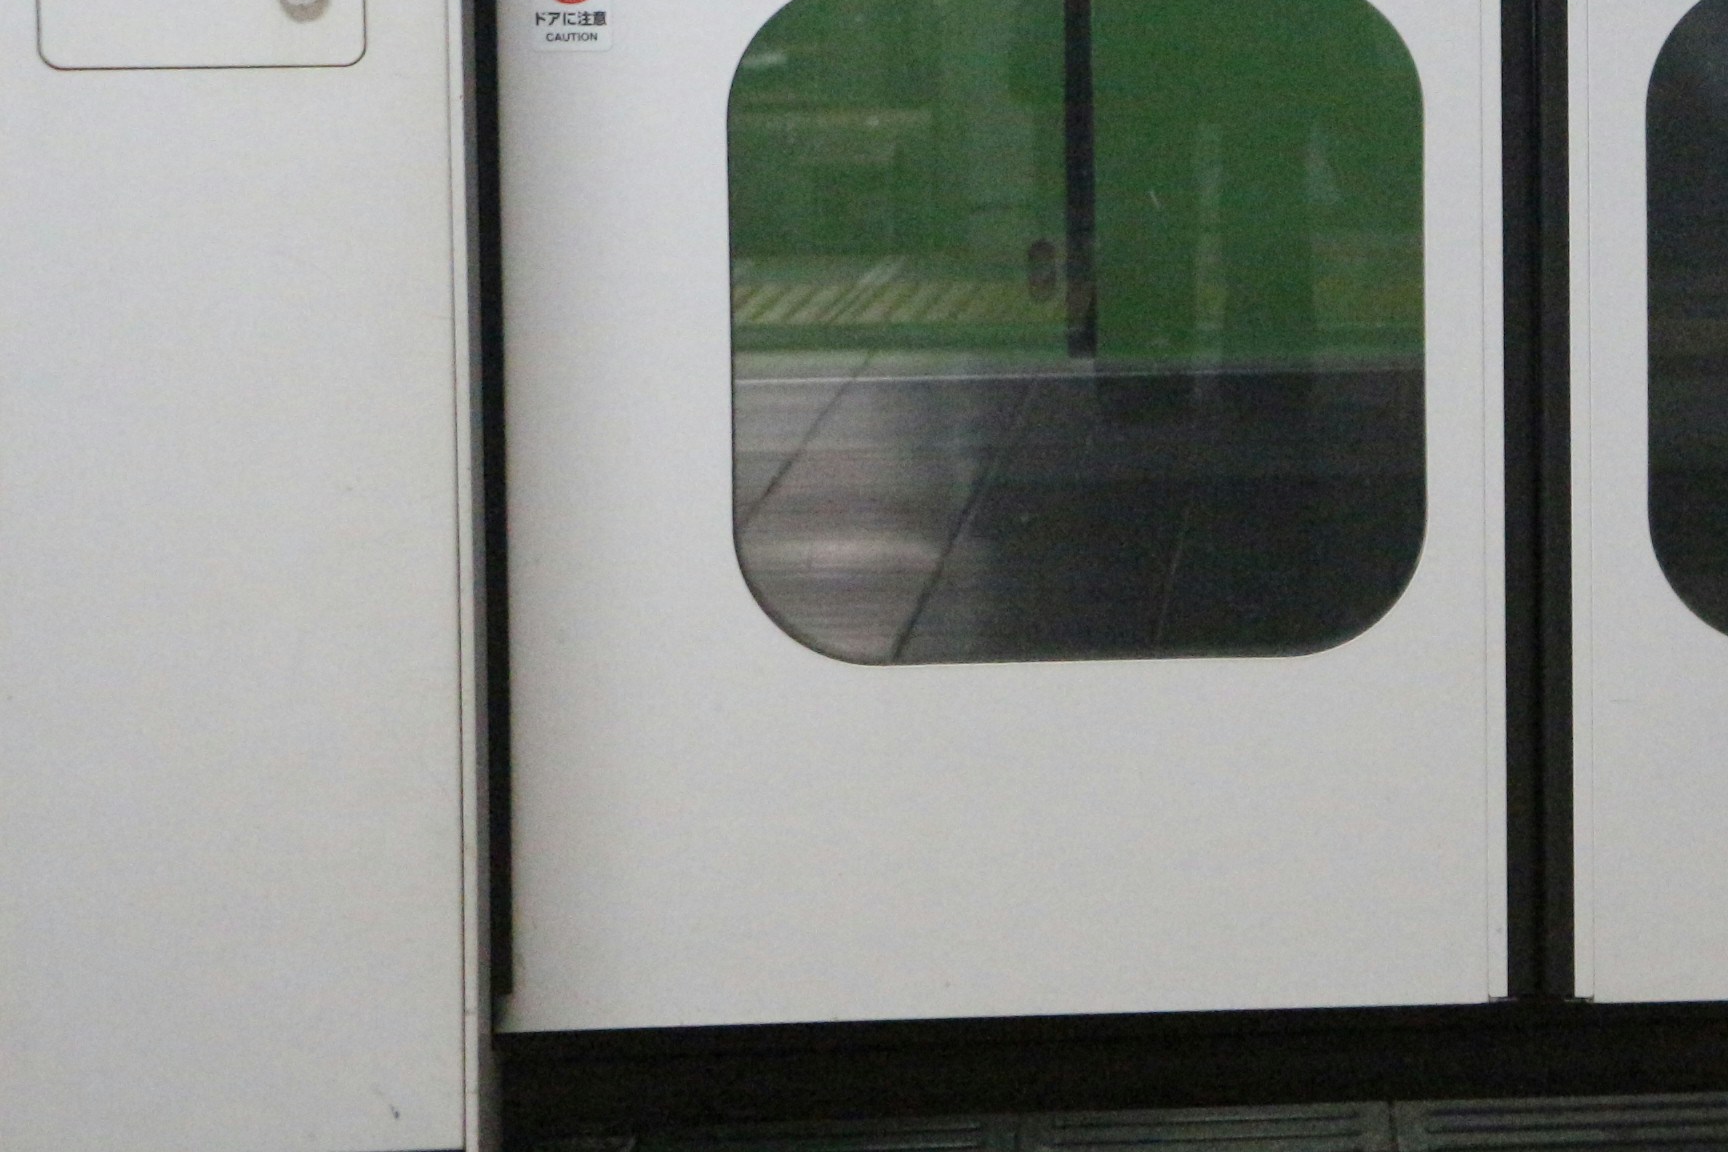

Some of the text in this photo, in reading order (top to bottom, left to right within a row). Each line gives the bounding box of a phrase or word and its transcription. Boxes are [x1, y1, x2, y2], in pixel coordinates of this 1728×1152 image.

[535, 10, 607, 26] ドアに注意
[546, 32, 598, 42] CAUTION
